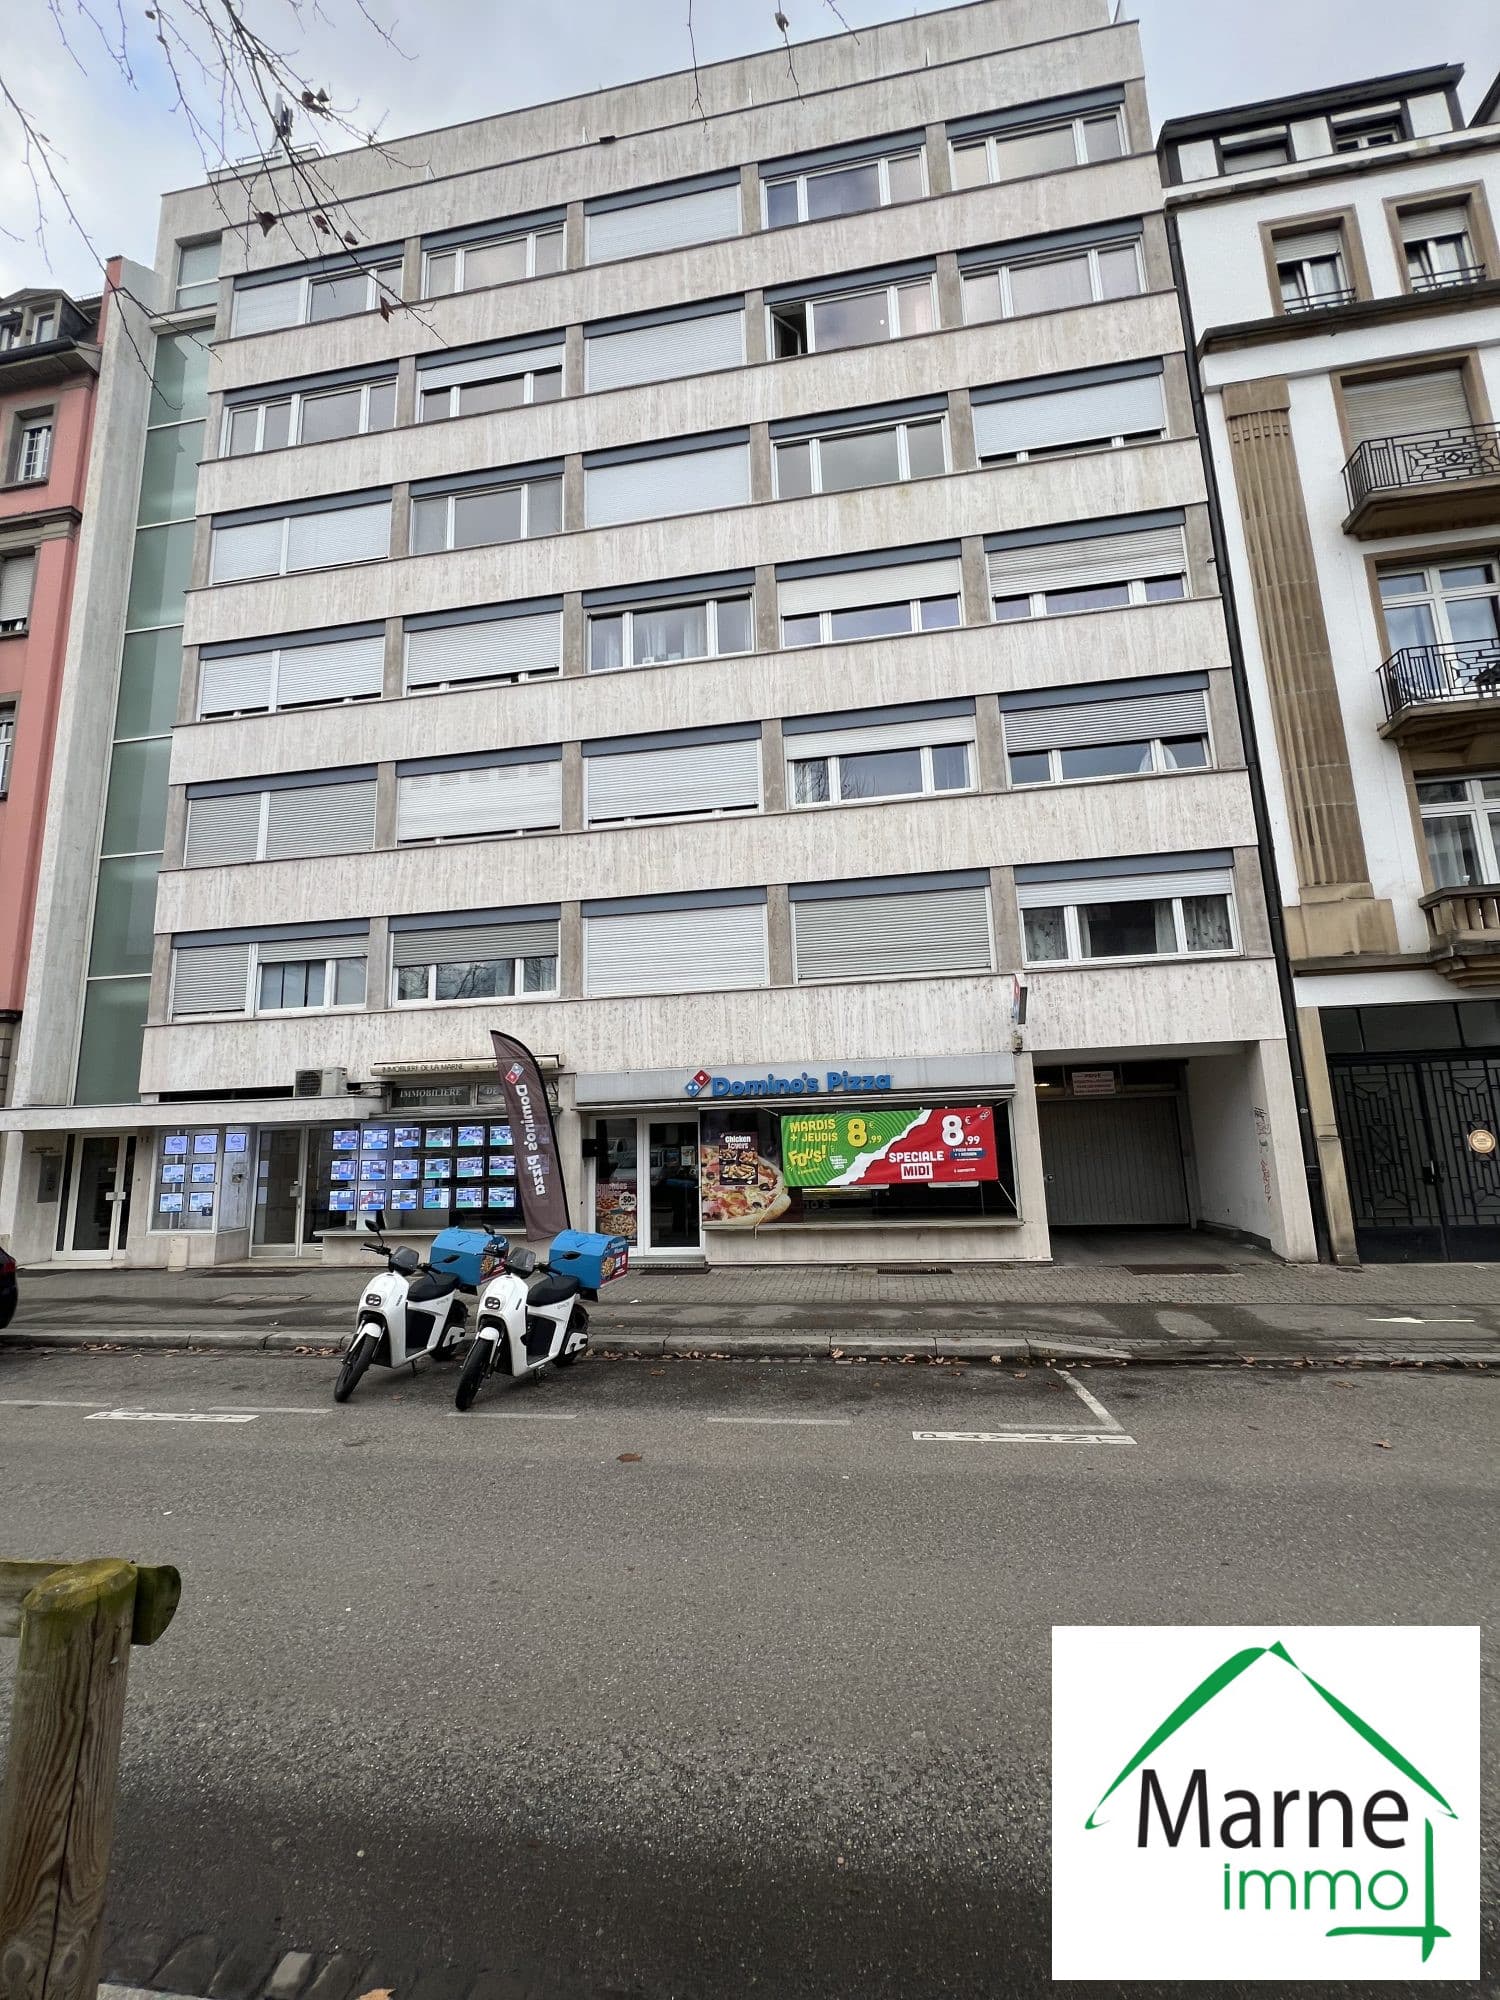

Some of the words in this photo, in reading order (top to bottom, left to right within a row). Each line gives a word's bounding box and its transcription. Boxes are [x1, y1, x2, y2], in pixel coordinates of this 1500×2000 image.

[711, 1072, 819, 1097] Domino's
[826, 1071, 891, 1092] Pizza
[790, 1119, 836, 1133] MARDIS
[847, 1118, 868, 1147] 8
[942, 1114, 964, 1147] 8
[801, 1132, 838, 1142] JEUDIS
[889, 1150, 945, 1163] SPECIALE
[903, 1165, 930, 1177] MIDI
